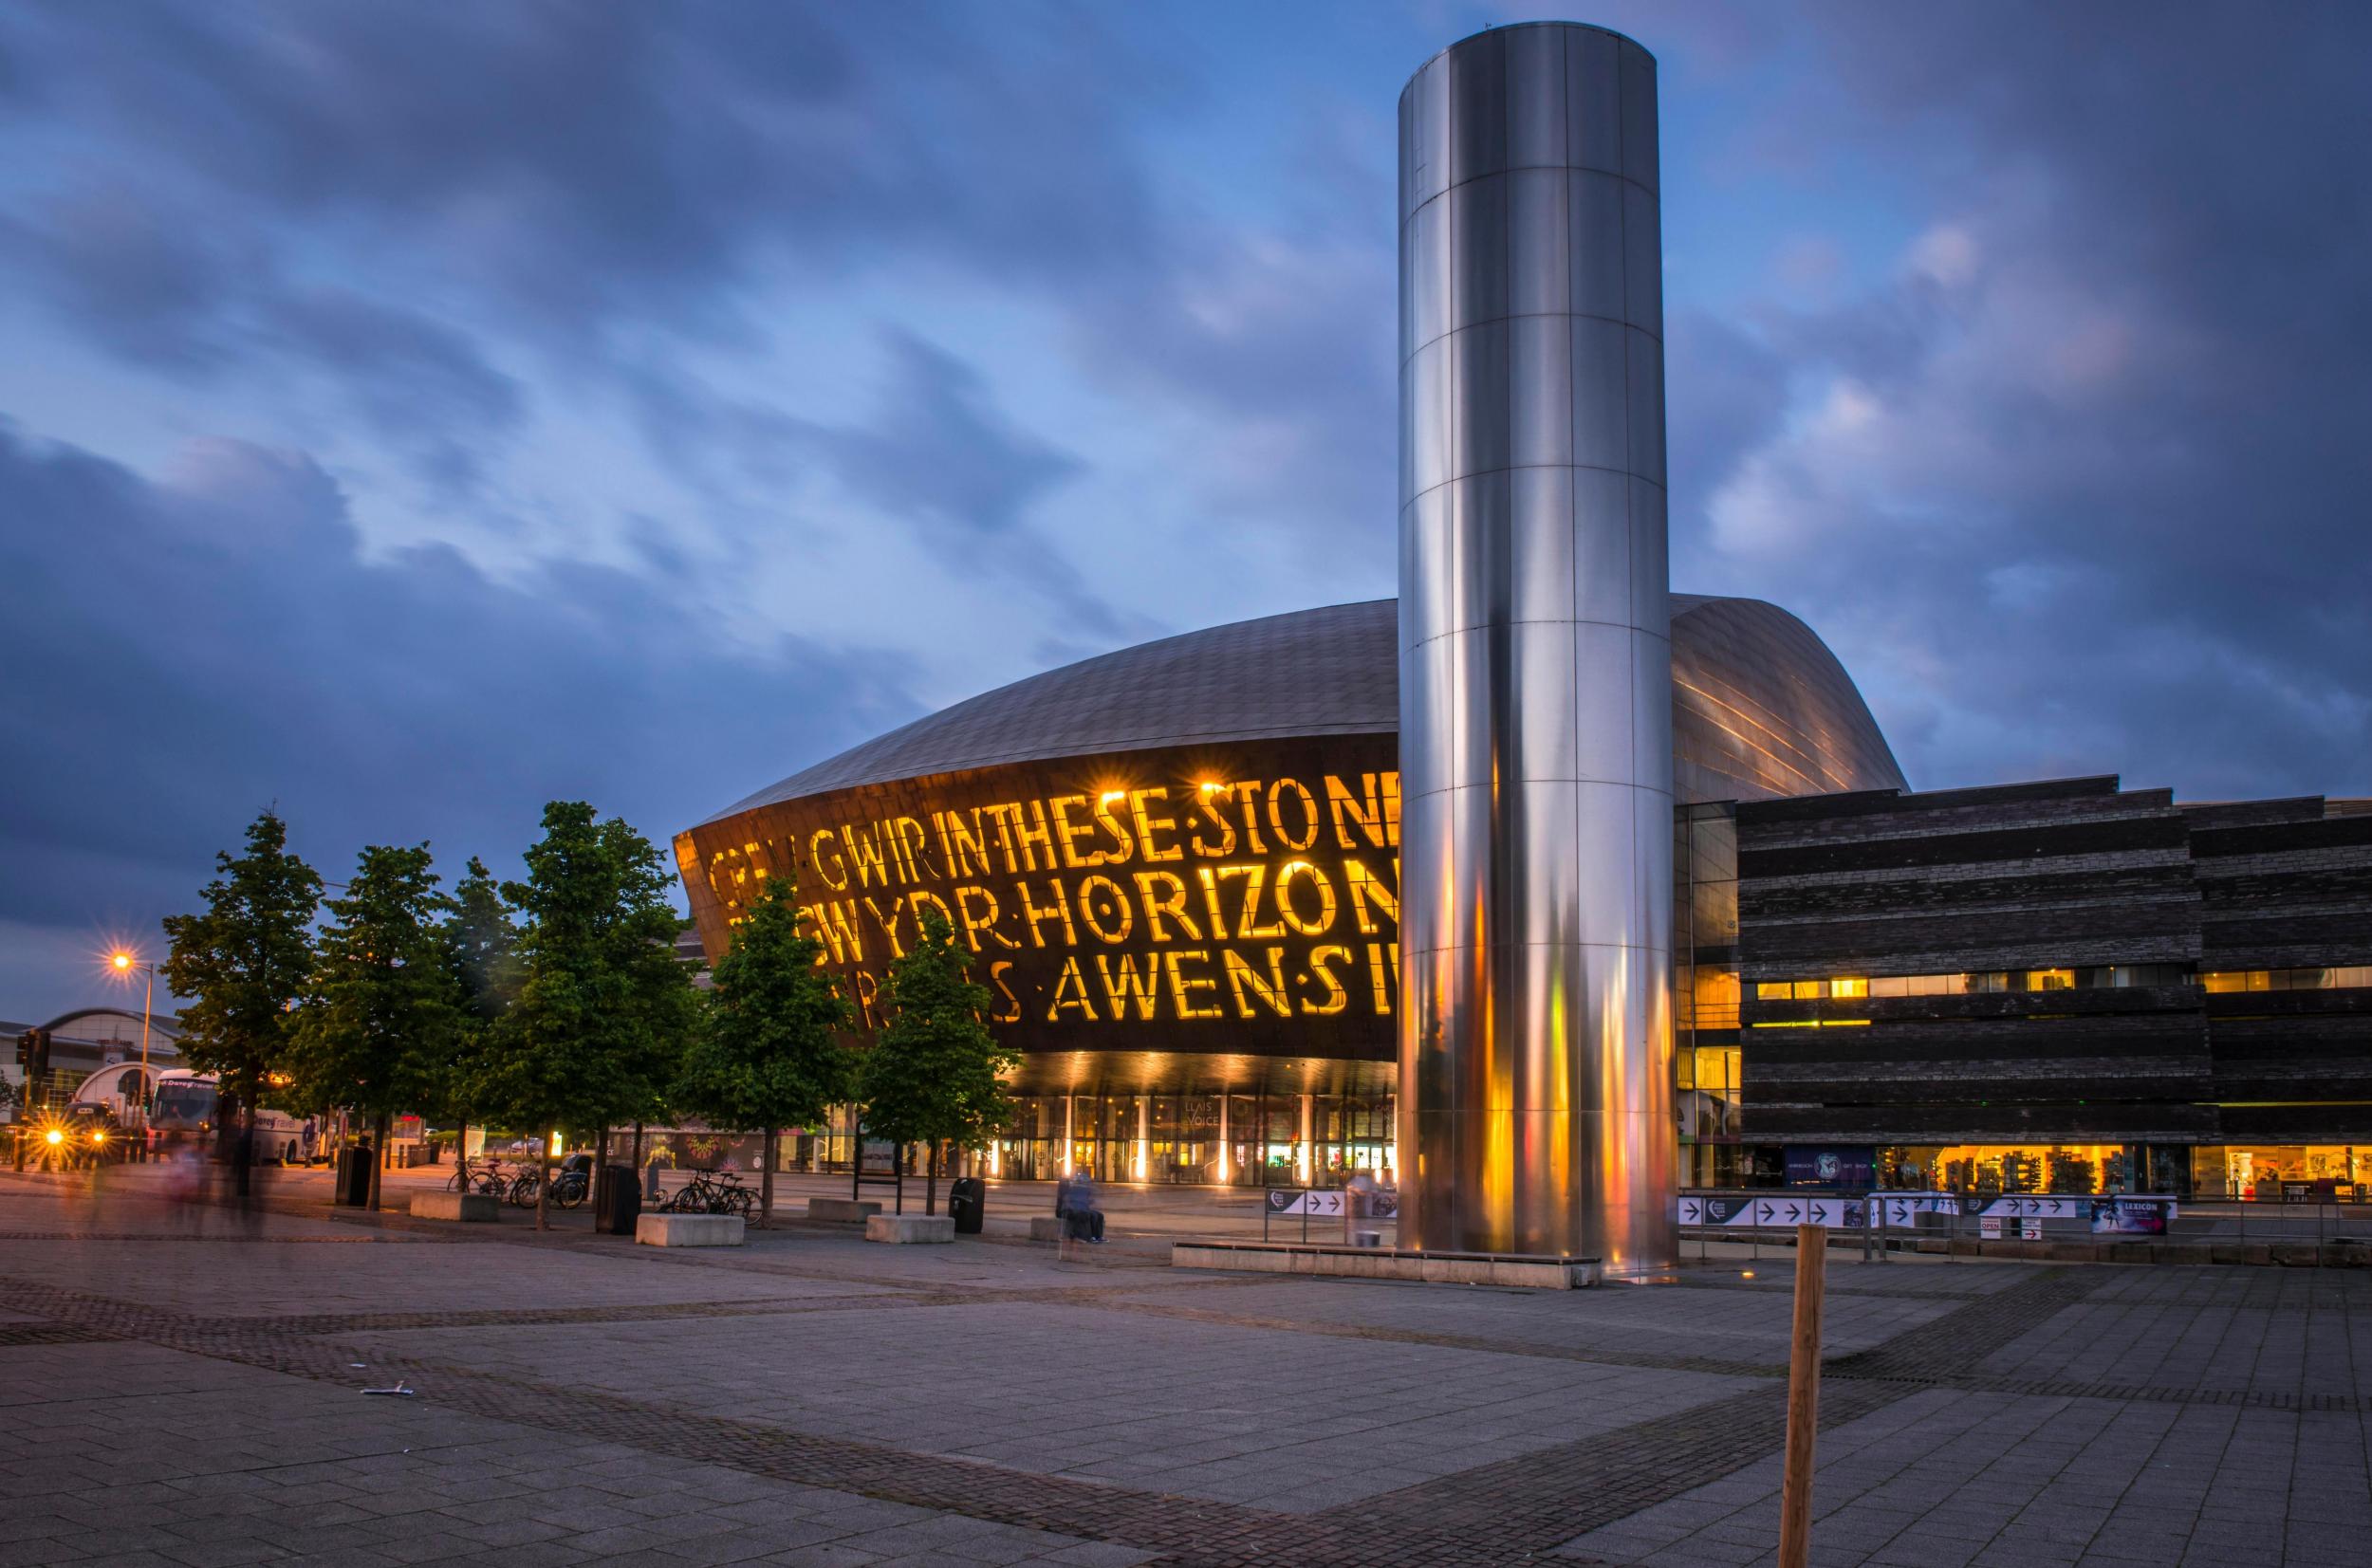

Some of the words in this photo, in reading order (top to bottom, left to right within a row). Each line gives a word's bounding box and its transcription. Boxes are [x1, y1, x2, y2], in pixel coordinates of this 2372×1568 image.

[809, 816, 940, 892] GWIR
[933, 807, 991, 878] IN
[982, 787, 1184, 874] THESE
[1047, 947, 1291, 1022] AWEN
[1301, 943, 1399, 1015] SI
[1185, 1101, 1212, 1112] LLAIS
[1187, 1116, 1219, 1126] VOICE
[2125, 1203, 2158, 1211] LEXICON
